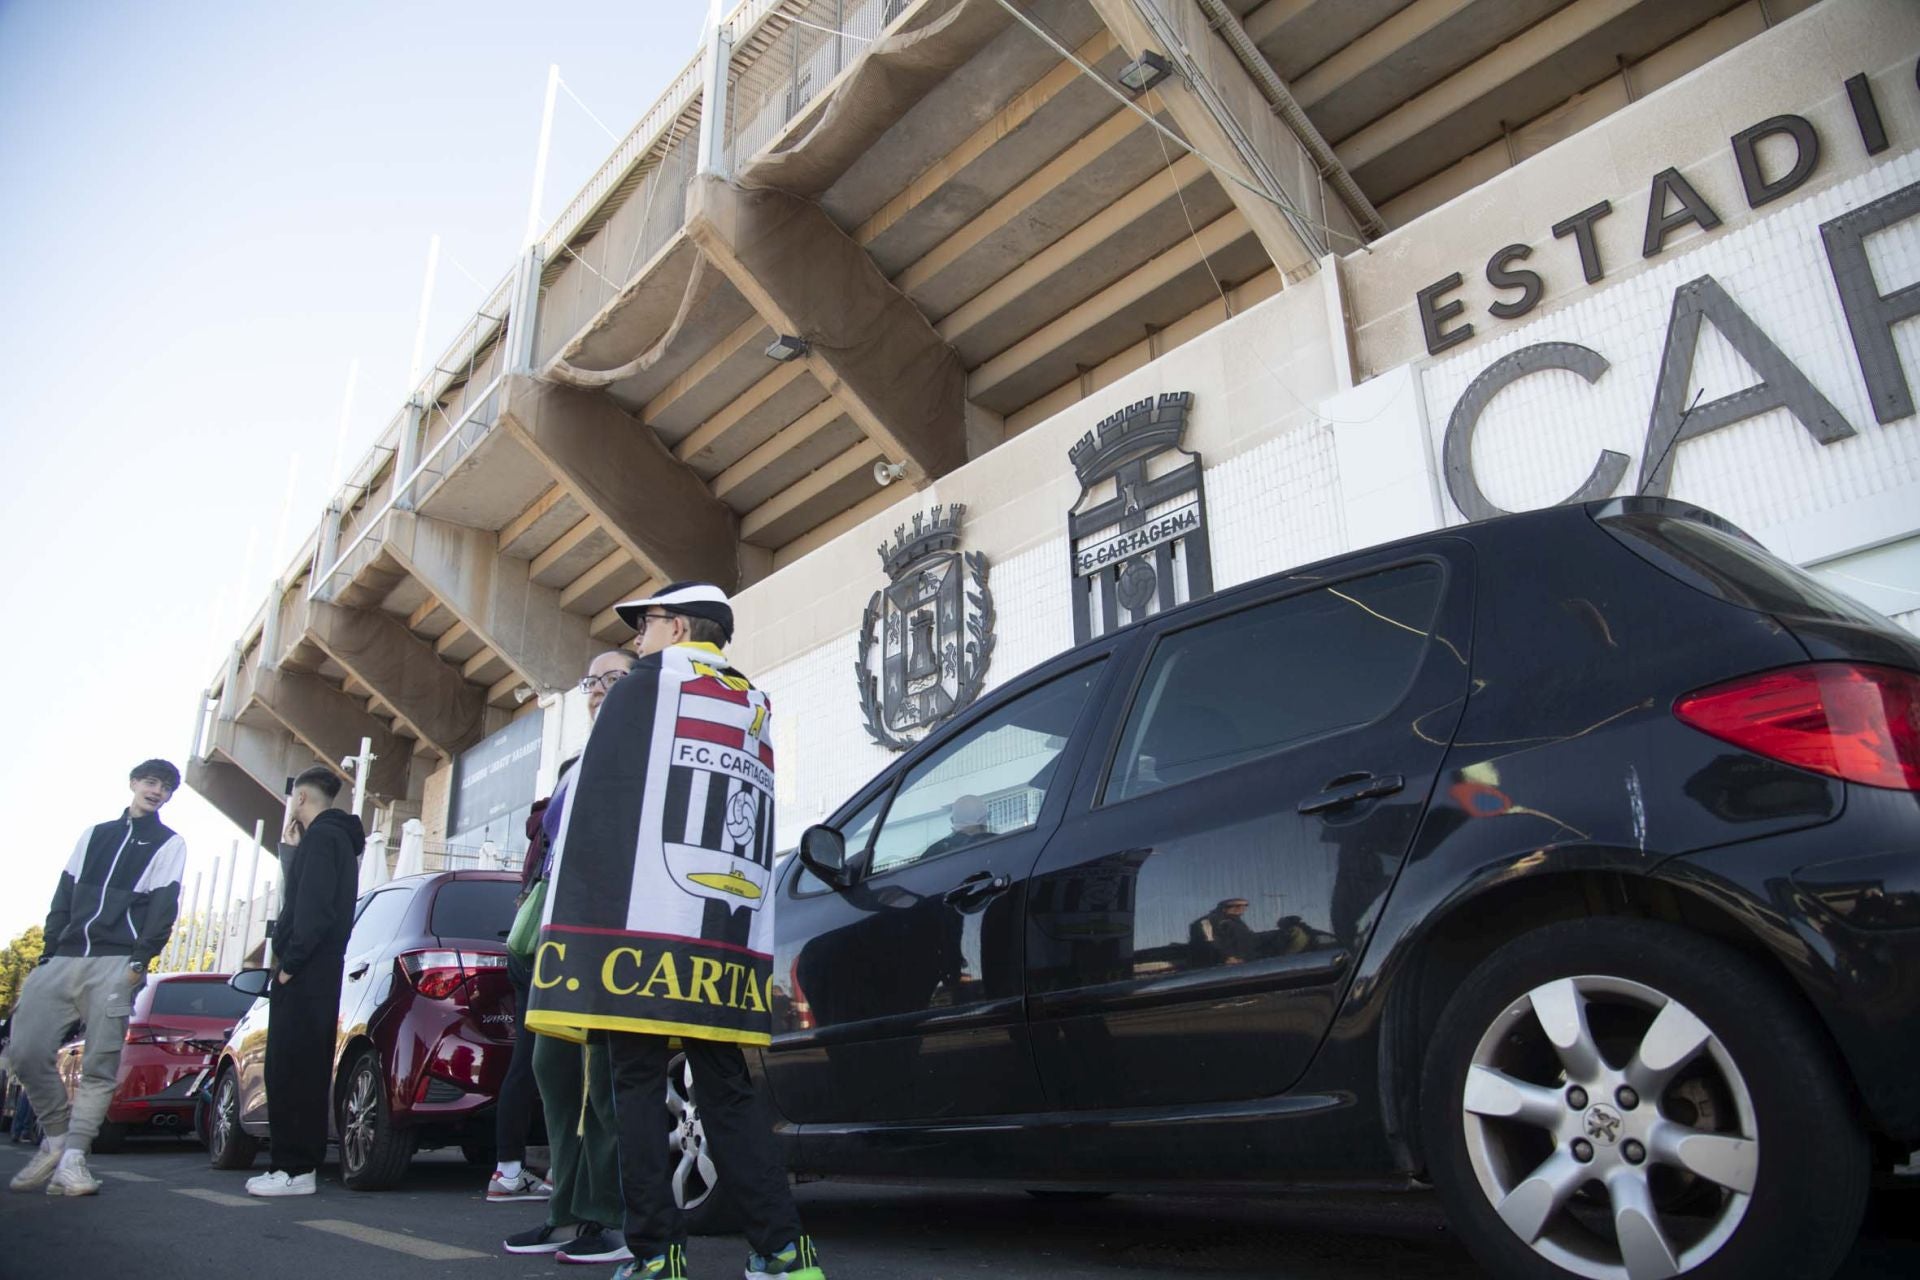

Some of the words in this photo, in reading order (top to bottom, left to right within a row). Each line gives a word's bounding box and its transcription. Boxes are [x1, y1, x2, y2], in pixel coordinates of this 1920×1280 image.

[1416, 57, 1920, 356] ESTADI
[1074, 553, 1093, 573] FC
[1096, 509, 1198, 564] CARTAGENA
[679, 744, 714, 766] F.C.
